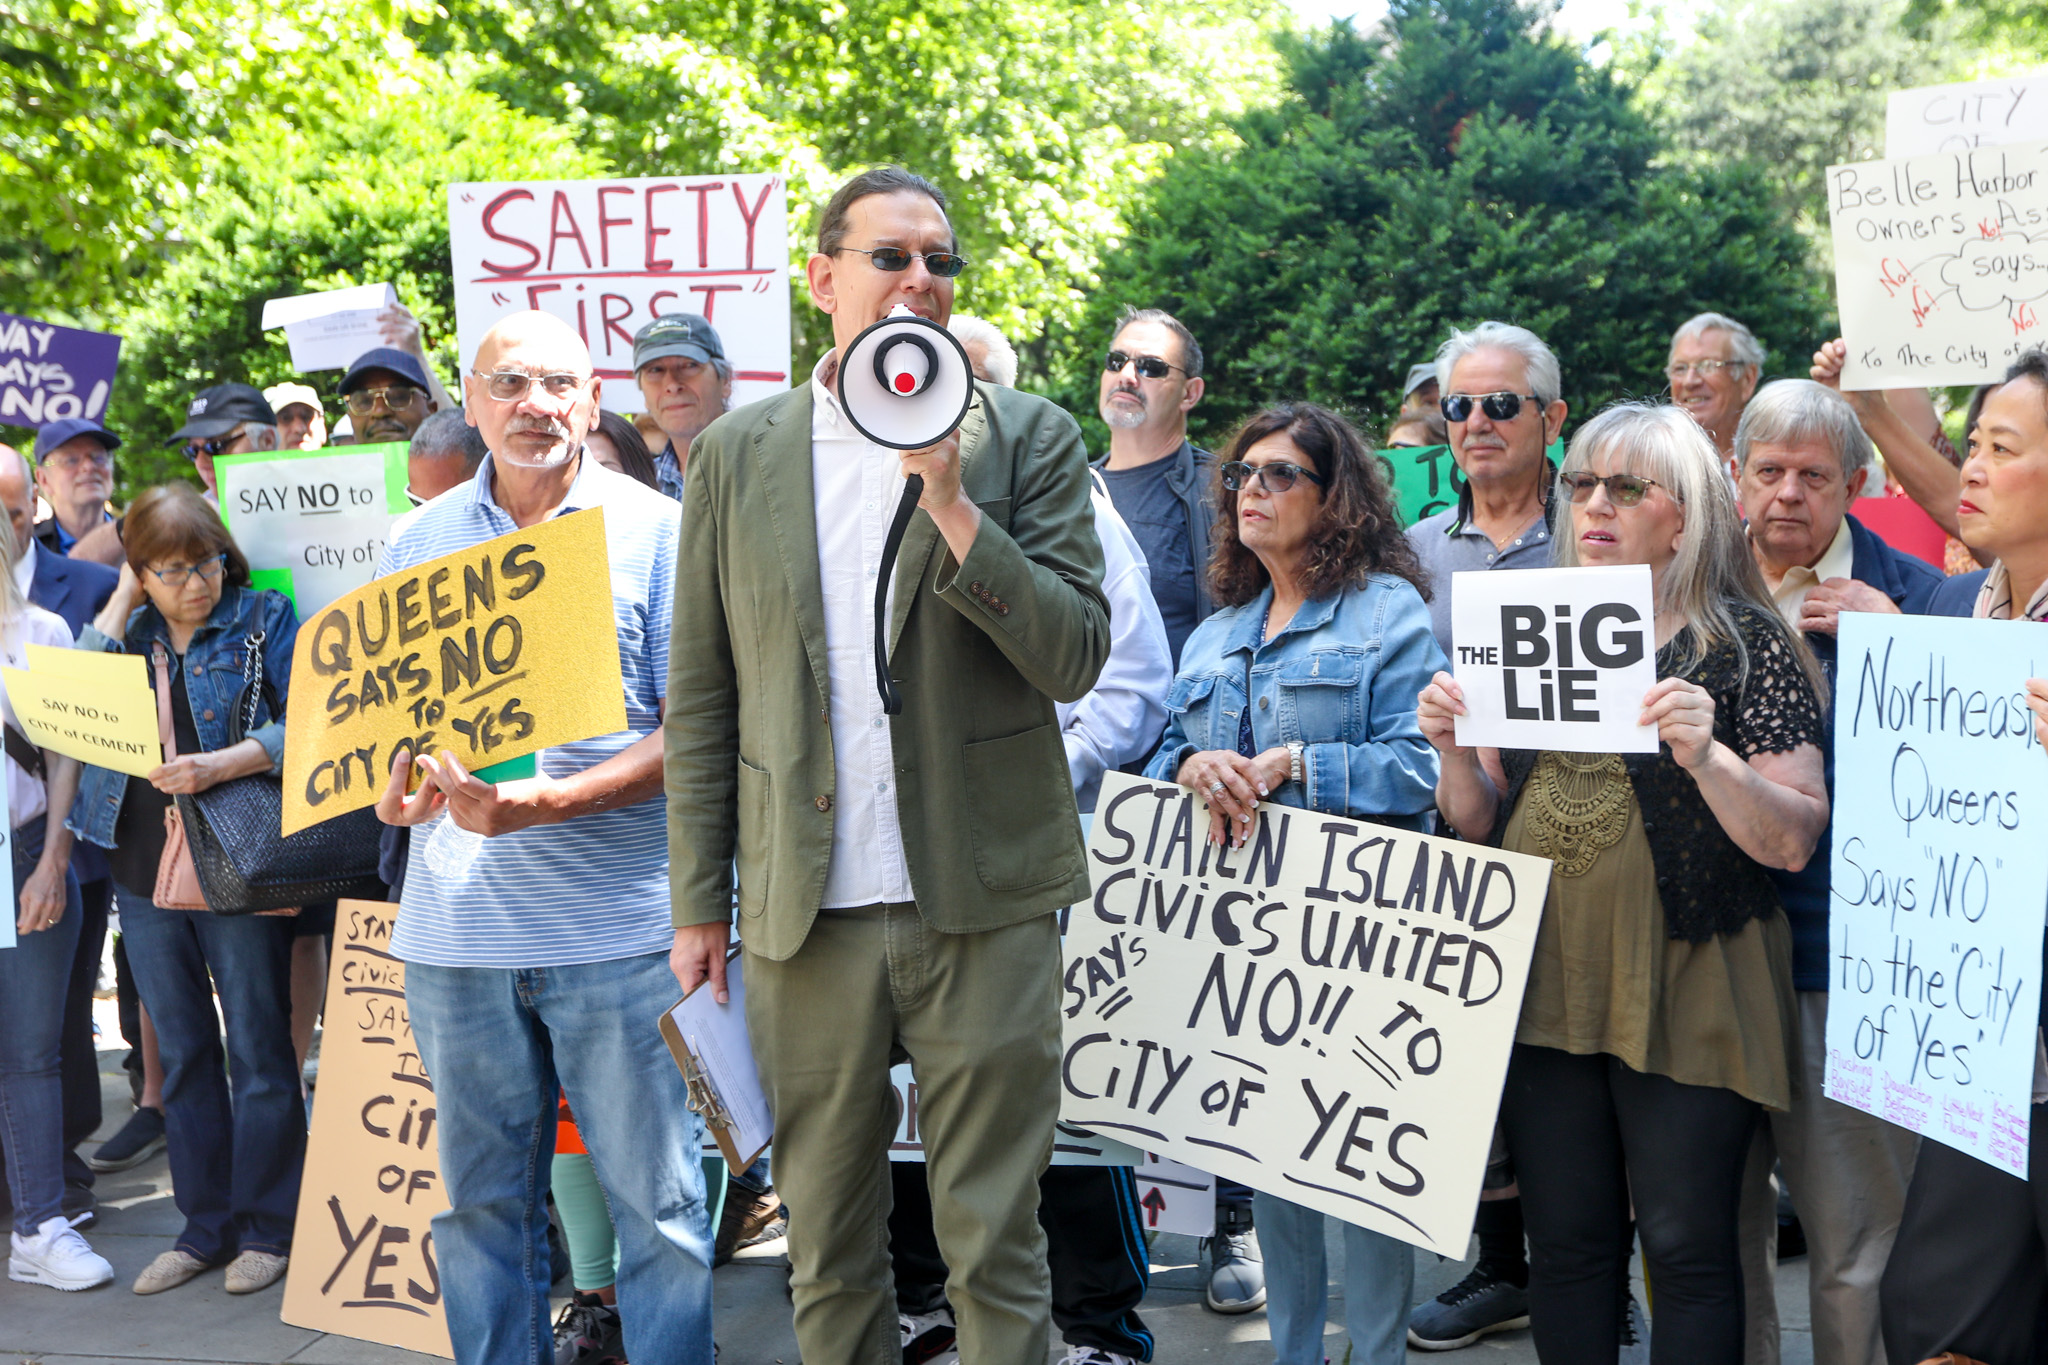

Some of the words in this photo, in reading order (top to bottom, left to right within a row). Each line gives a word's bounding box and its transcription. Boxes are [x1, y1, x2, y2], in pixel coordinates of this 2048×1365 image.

[1923, 87, 2026, 127] CITY
[1834, 161, 1938, 216] Belle
[1955, 152, 2038, 199] Harbor
[1856, 211, 1965, 243] Owners
[1897, 344, 1936, 368] The
[1945, 345, 1988, 369] City
[239, 486, 288, 514] SAY
[297, 483, 339, 509] NO
[349, 486, 373, 505] to
[304, 545, 345, 570] City
[353, 540, 374, 563] of
[310, 543, 545, 677] QUEENS
[325, 652, 432, 728] SAYS
[439, 614, 523, 697] NO
[1457, 646, 1498, 665] THE
[28, 717, 58, 733] CITY
[64, 728, 78, 740] of
[82, 732, 148, 756] CEMENT
[42, 697, 69, 713] SAY
[74, 705, 99, 720] NO
[104, 712, 119, 724] to
[407, 696, 446, 729] TO
[452, 697, 535, 754] YES
[1891, 742, 2020, 838] Queens
[1305, 822, 1516, 932] ISLAND
[1830, 836, 1916, 933] Says
[1839, 924, 1874, 994] to
[1883, 935, 1947, 1008] the
[1187, 952, 1354, 1057] NO!!
[1379, 1000, 1442, 1076] TO
[1854, 1004, 1897, 1062] of
[1200, 1077, 1265, 1127] OF
[1299, 1078, 1429, 1197] YES
[378, 1164, 437, 1205] OF
[321, 1194, 441, 1305] YES
